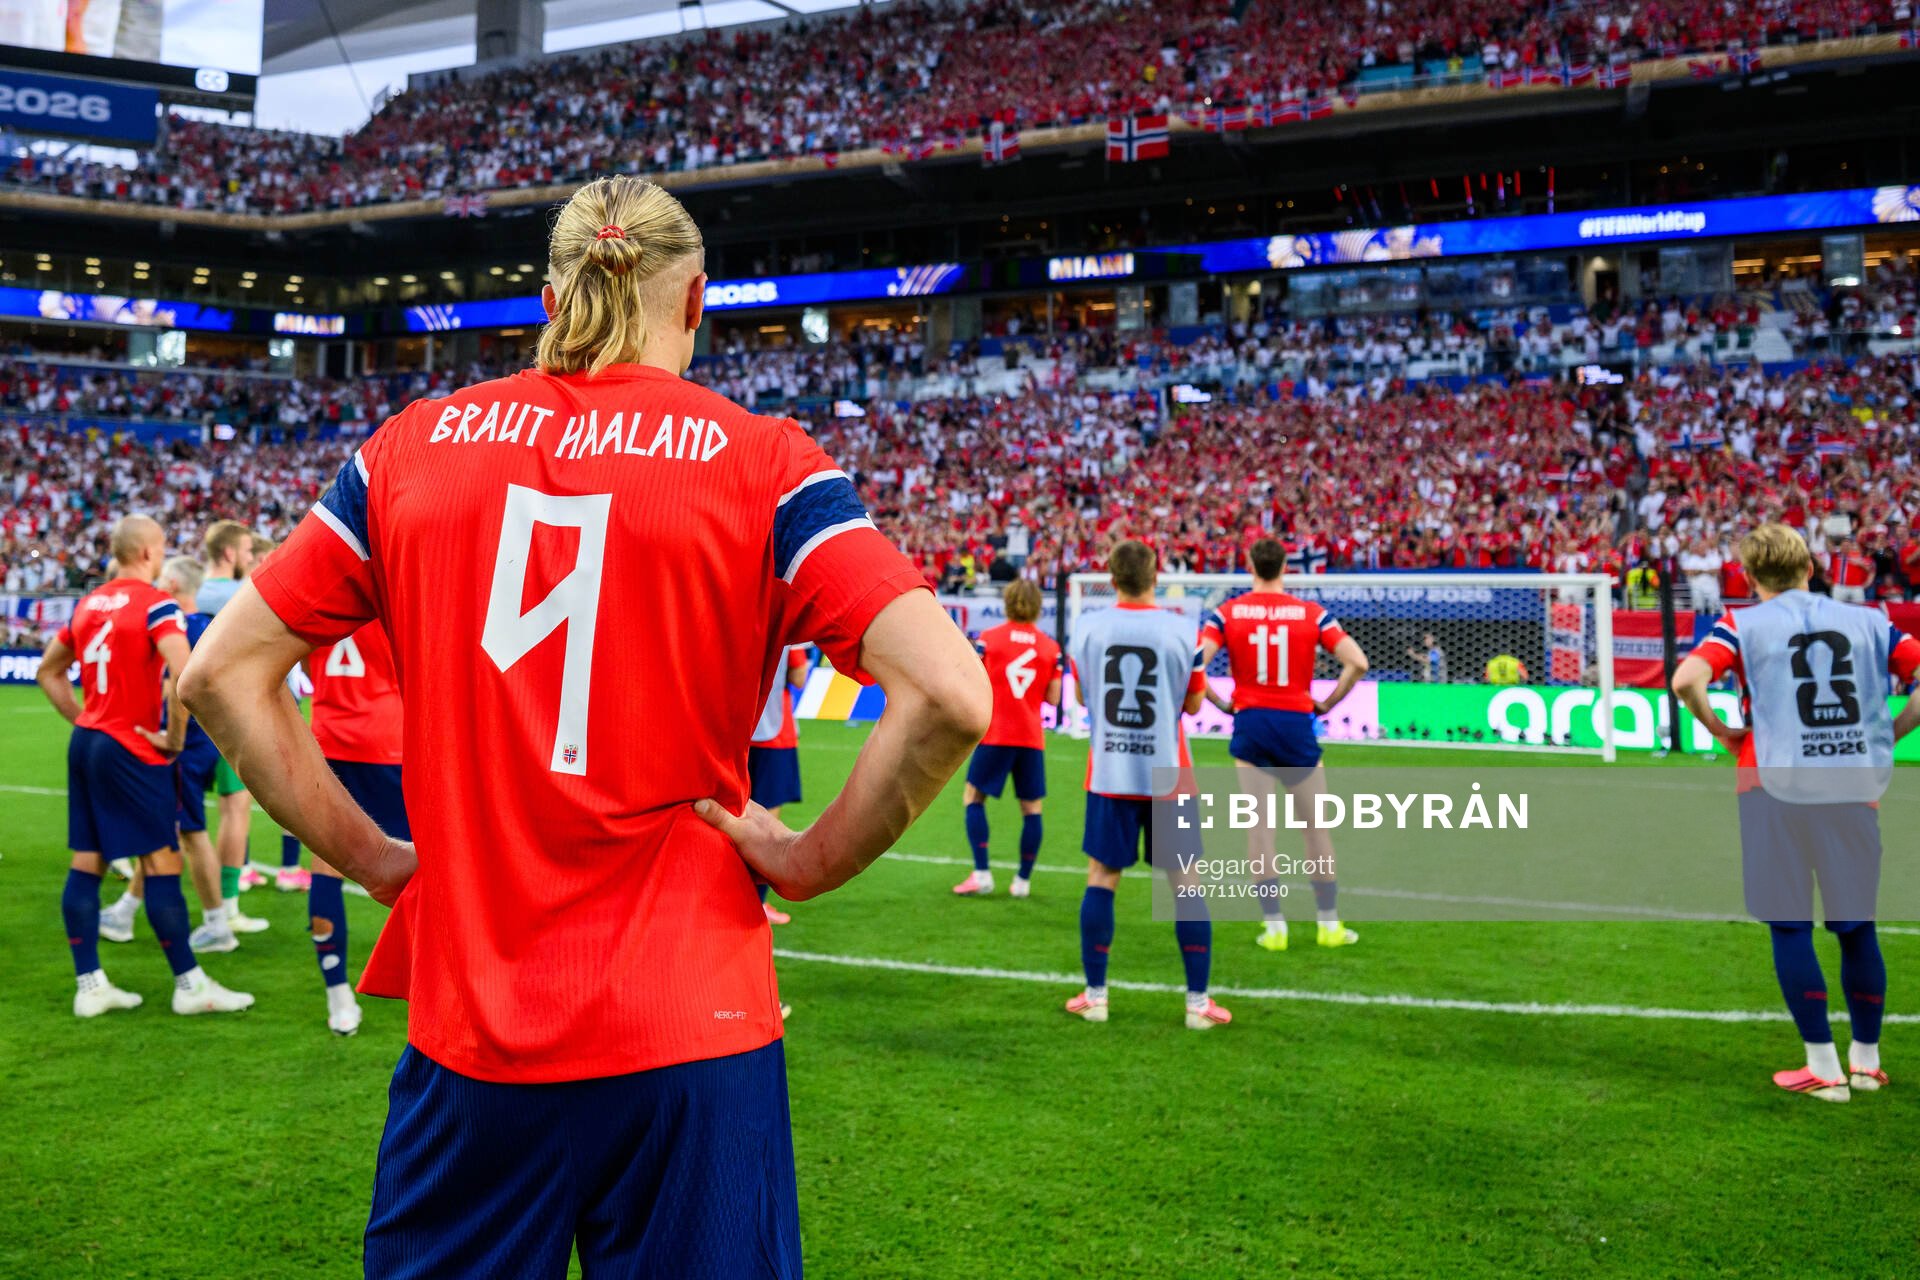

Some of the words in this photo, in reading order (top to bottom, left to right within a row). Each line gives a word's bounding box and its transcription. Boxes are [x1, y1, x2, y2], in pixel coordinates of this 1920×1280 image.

[1049, 253, 1135, 280] MIAMI
[703, 281, 778, 306] 2026
[430, 401, 555, 447] BRAUT
[554, 409, 729, 462] HAALAND
[1387, 586, 1426, 601] CUP
[1427, 587, 1494, 602] 2026
[480, 482, 613, 776] 9
[83, 620, 113, 694] 4
[1248, 624, 1289, 687] 11
[1006, 648, 1037, 699] 6
[1117, 711, 1144, 724] FIFA
[1813, 706, 1849, 720] FIFA
[1105, 741, 1155, 756] 2026
[1801, 732, 1844, 741] WORLD
